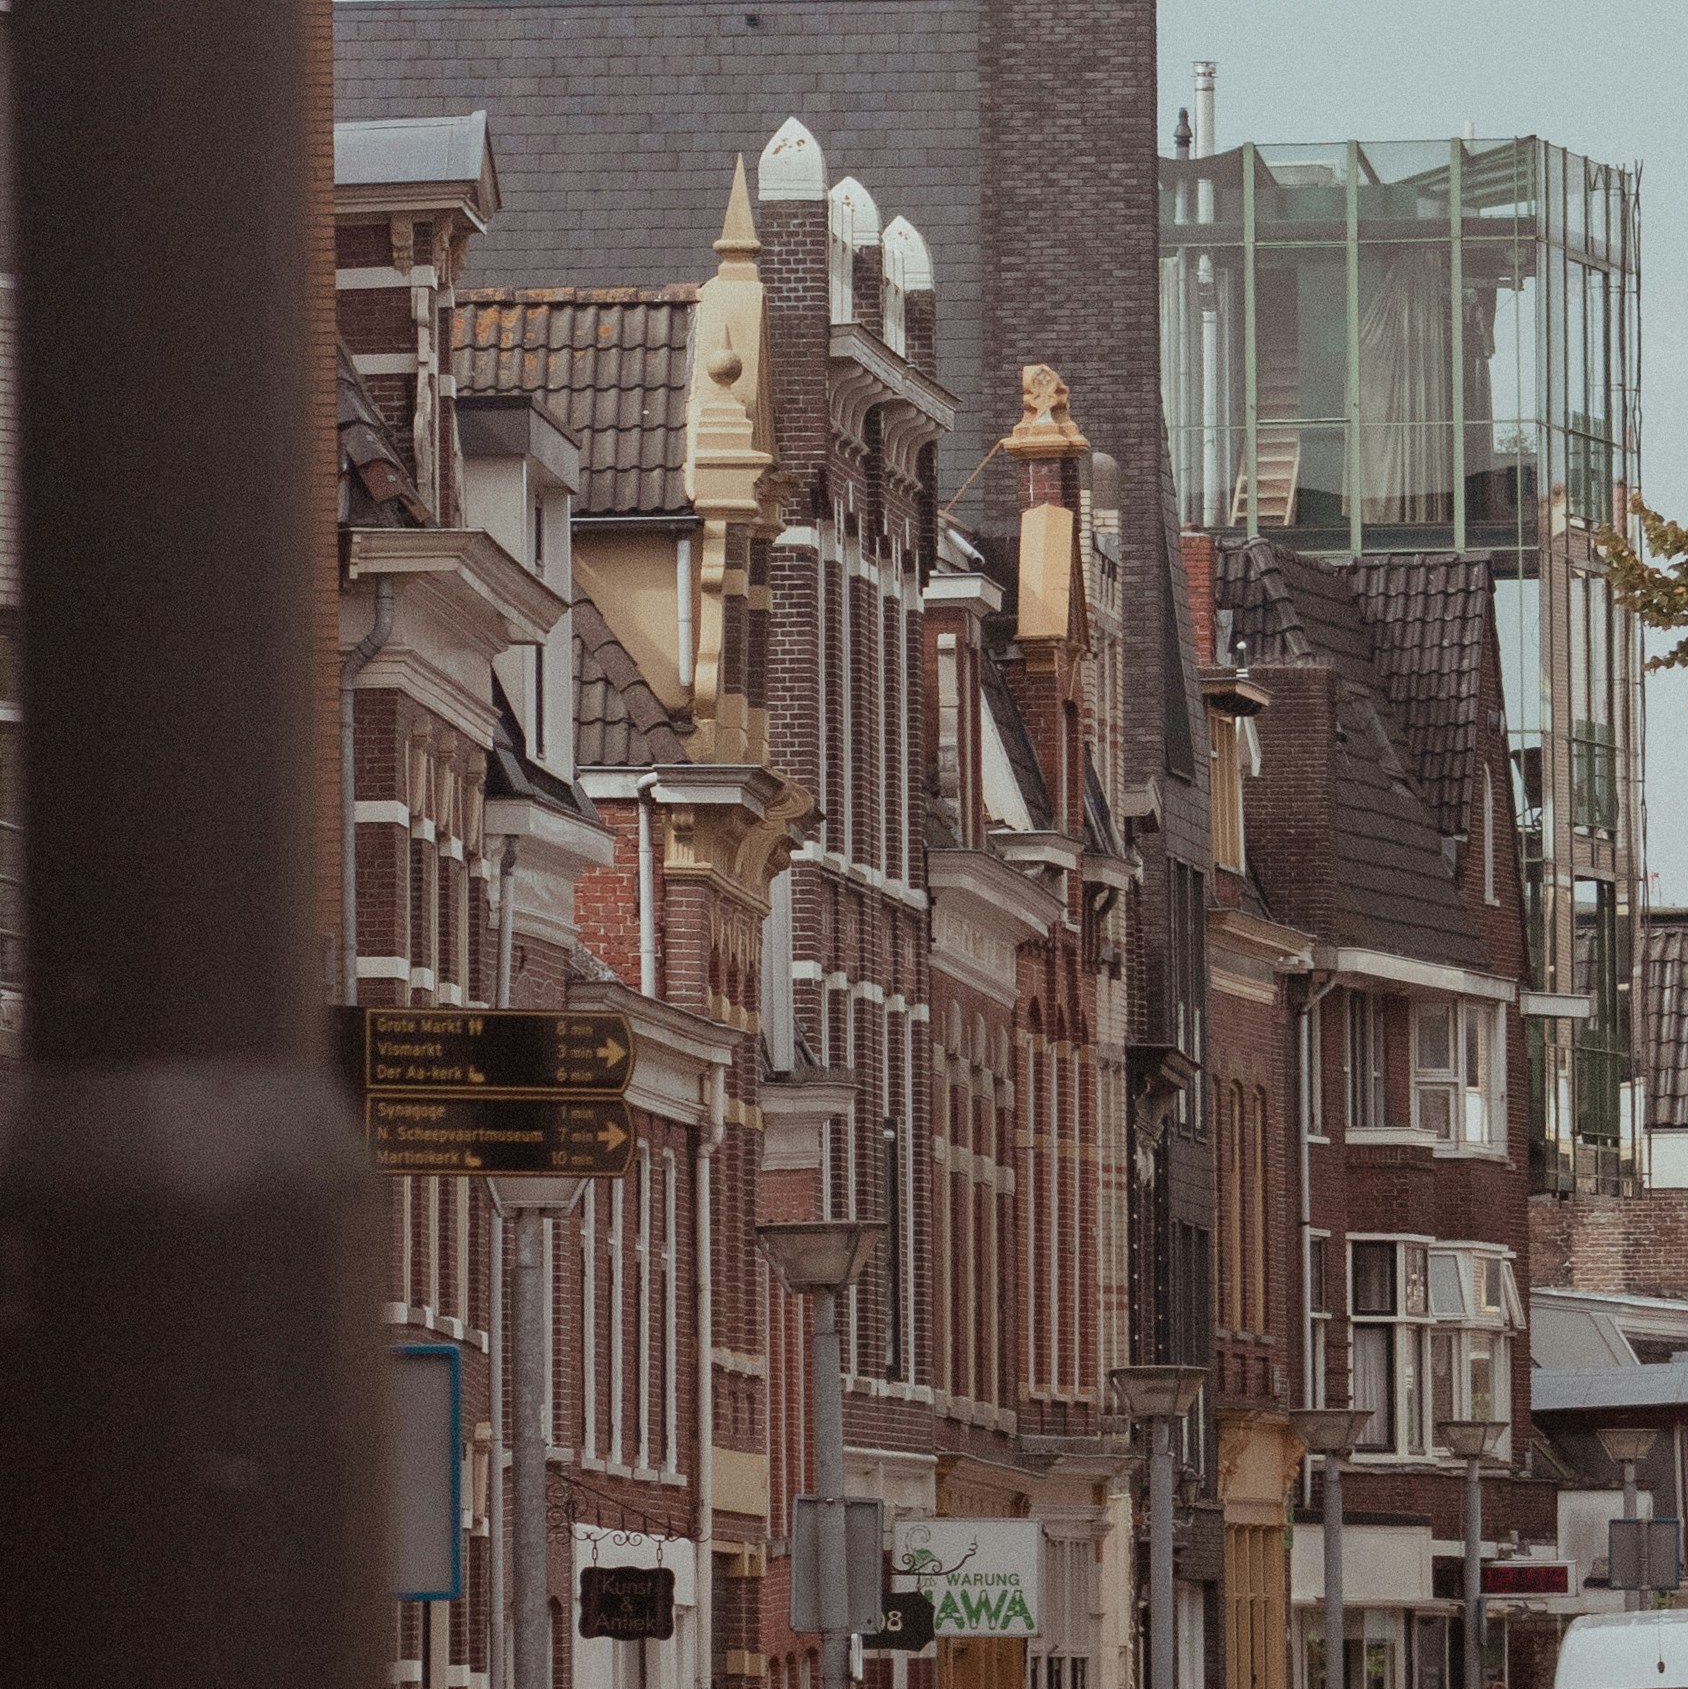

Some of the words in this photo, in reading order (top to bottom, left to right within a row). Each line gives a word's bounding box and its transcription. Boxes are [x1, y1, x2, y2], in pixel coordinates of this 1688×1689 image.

[378, 1018, 415, 1032] Grote
[421, 1019, 462, 1032] Markt
[378, 1042, 442, 1056] Vismarkt
[557, 1044, 567, 1058] 3
[571, 1048, 593, 1058] min
[378, 1065, 400, 1079] Der
[377, 1103, 446, 1120] Synagoge
[398, 1127, 544, 1142] Scheepvaartmuseum
[378, 1151, 459, 1164] Martinikerk
[602, 1575, 652, 1595] Kunst
[946, 1573, 1020, 1586] WARUNG
[594, 1612, 656, 1631] Antiek
